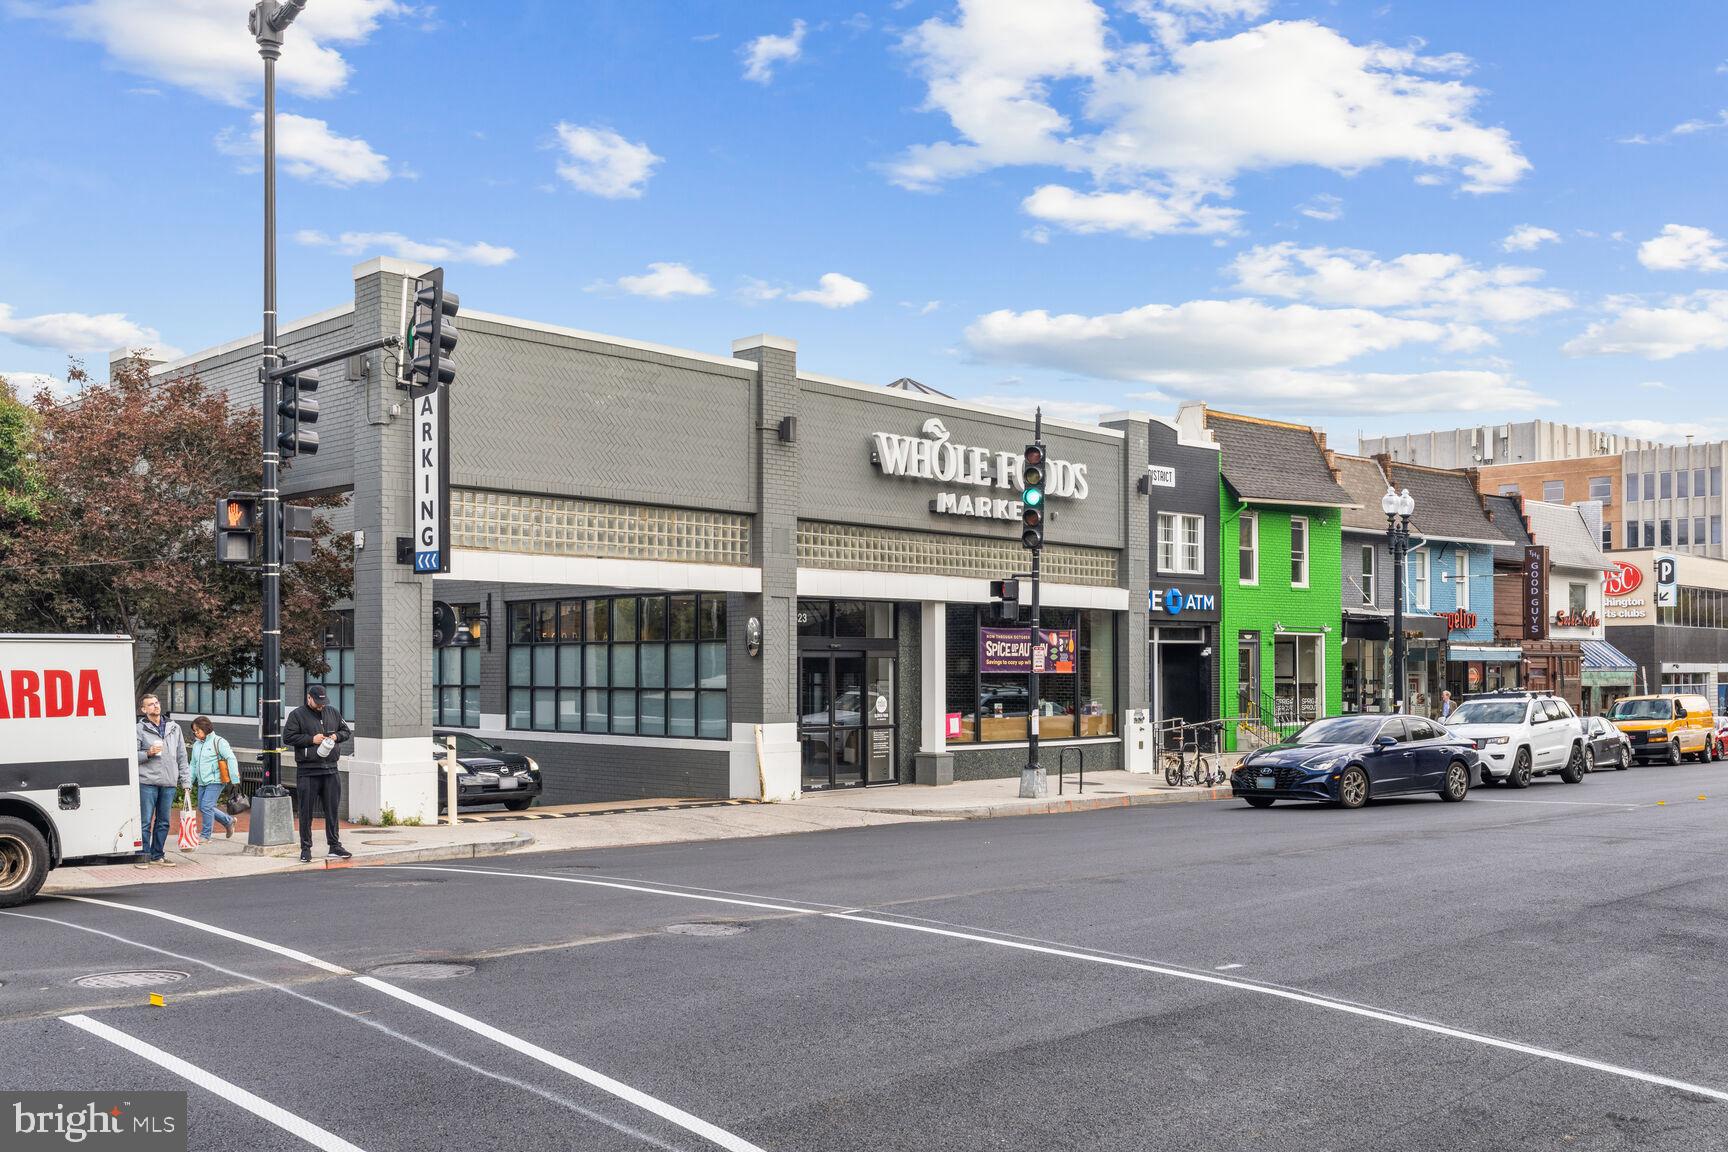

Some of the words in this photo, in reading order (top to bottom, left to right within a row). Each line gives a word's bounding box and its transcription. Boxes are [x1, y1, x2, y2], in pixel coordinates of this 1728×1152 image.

[872, 424, 992, 486] WHOLE
[420, 395, 434, 547] ARKING
[936, 491, 1024, 521] MARKE
[1528, 549, 1540, 560] THE
[1530, 562, 1539, 595] GOOD
[1661, 562, 1672, 581] P
[1185, 594, 1215, 611] ATM
[1619, 609, 1646, 618] clubs
[797, 613, 808, 623] 23
[1530, 598, 1539, 633] GUYS
